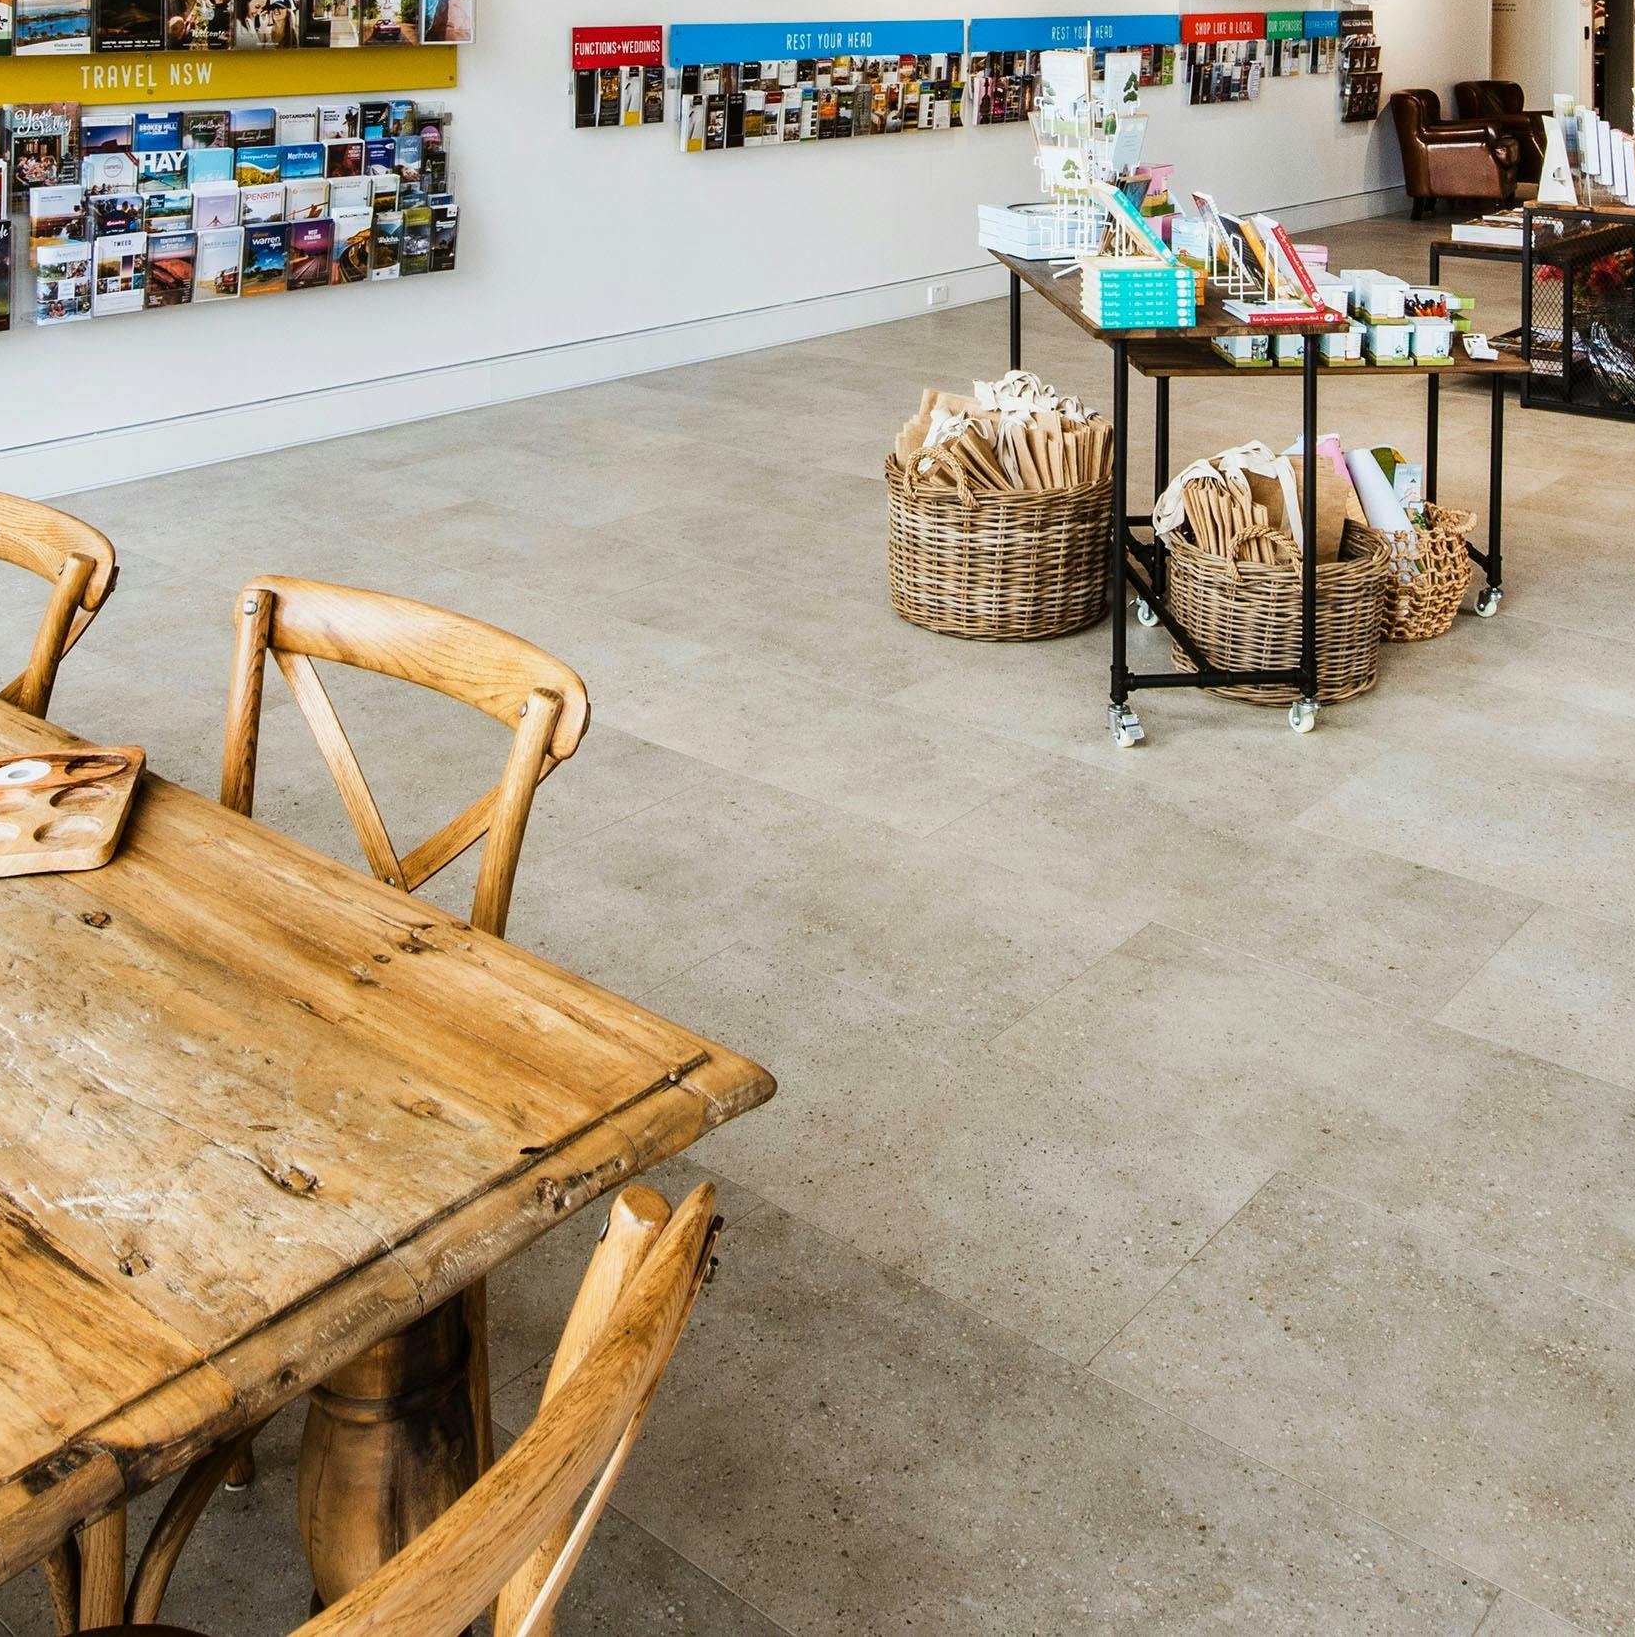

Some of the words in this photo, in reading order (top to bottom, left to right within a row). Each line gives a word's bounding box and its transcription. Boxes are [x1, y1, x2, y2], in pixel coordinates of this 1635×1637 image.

[1051, 26, 1070, 41] REST
[1073, 26, 1091, 39] YOU
[1096, 25, 1113, 38] HEAD
[1195, 21, 1211, 35] SHOP
[1213, 21, 1226, 35] LIKE
[1228, 21, 1233, 34] A
[1236, 21, 1253, 34] LOCAL
[1268, 20, 1277, 33] OUR
[1278, 19, 1302, 32] SPONSORS
[786, 33, 811, 50] REST
[818, 33, 842, 49] YOUR
[848, 32, 872, 48] HEAD
[81, 64, 157, 89] TRAVEL
[170, 62, 213, 85] NSW
[14, 107, 53, 135] Yass
[33, 115, 72, 135] Valley
[139, 152, 186, 173] HAY
[245, 192, 281, 201] PENRITH
[252, 236, 281, 246] warren
